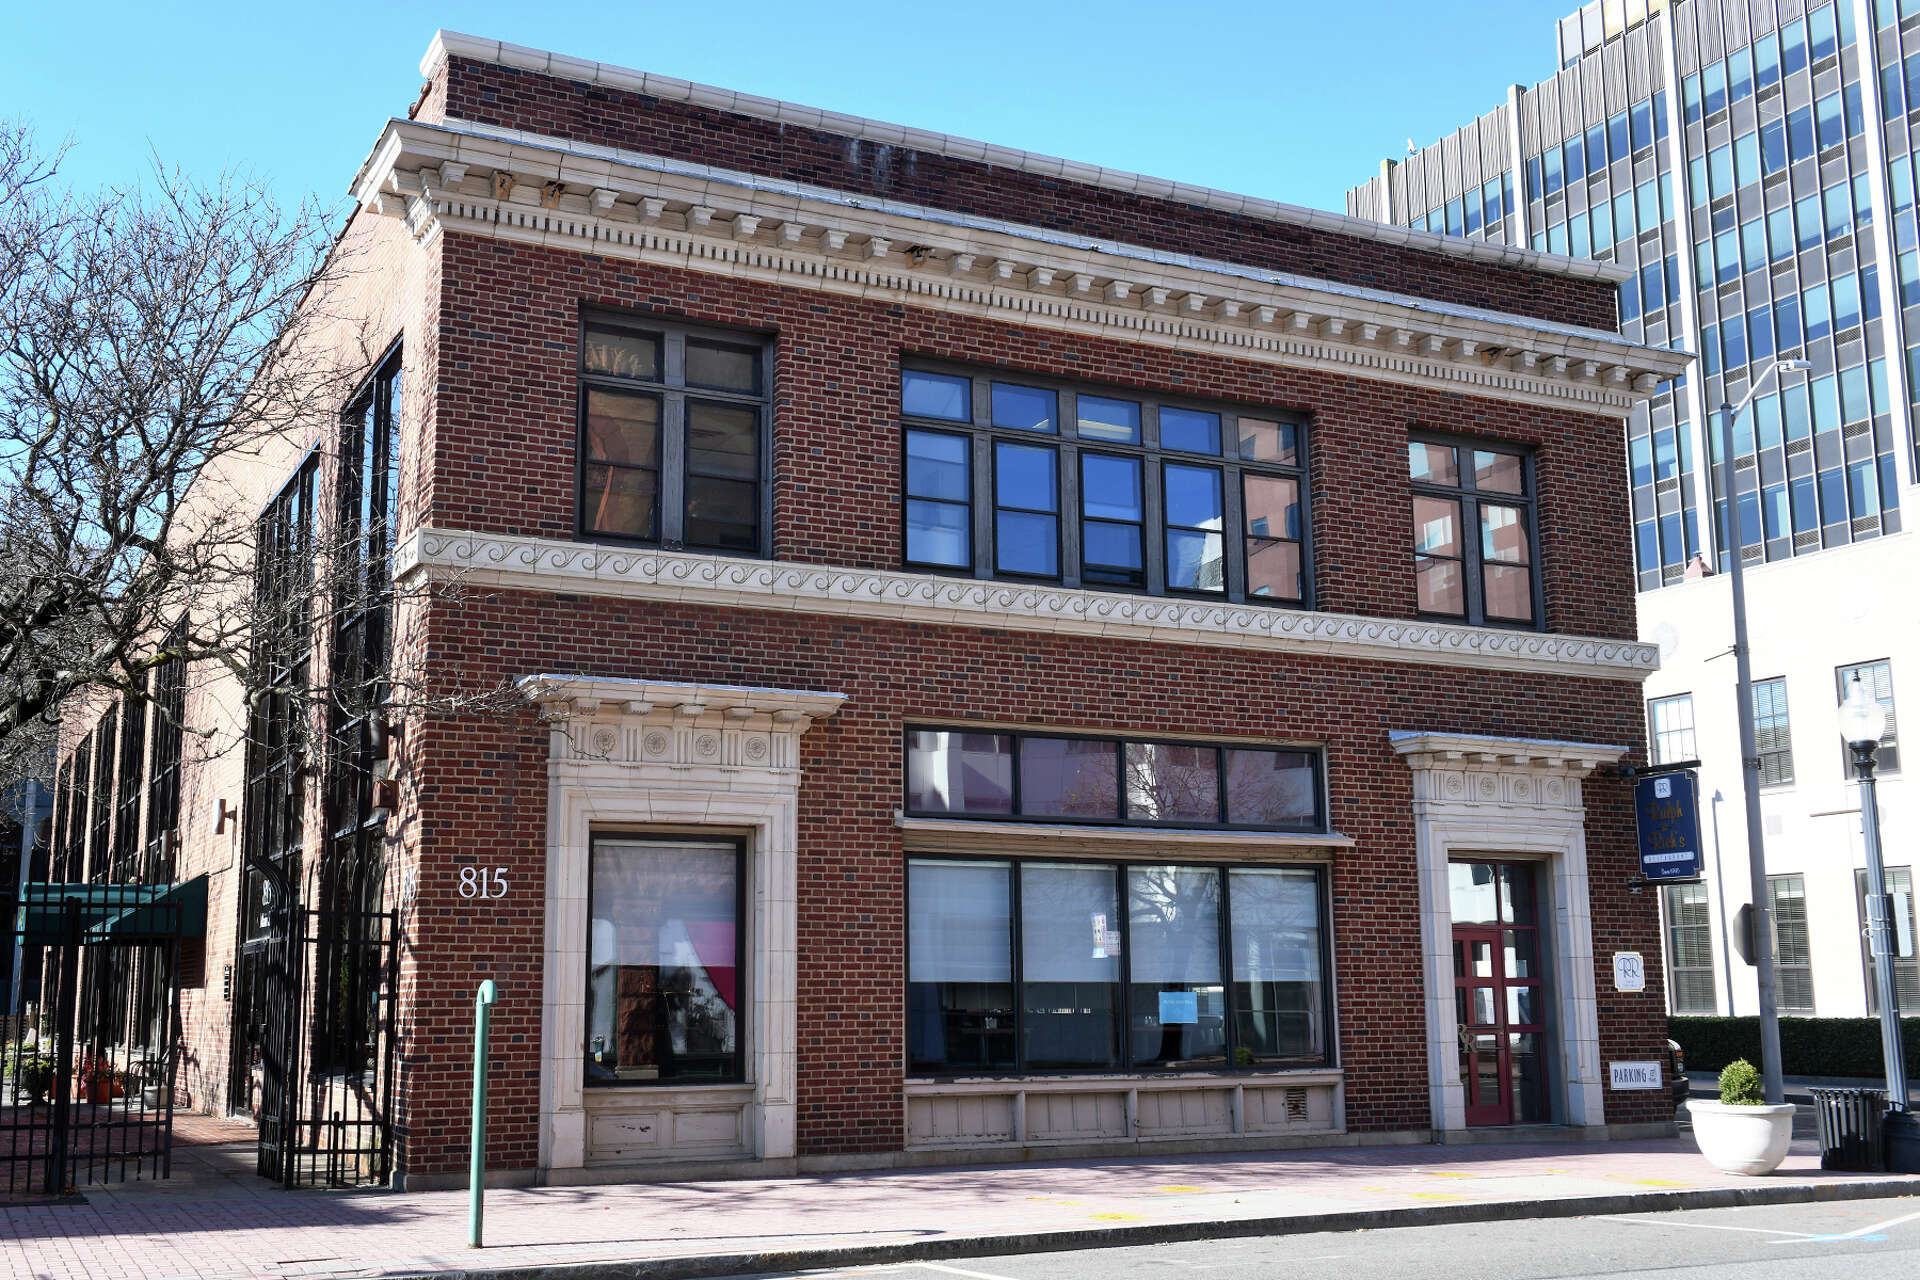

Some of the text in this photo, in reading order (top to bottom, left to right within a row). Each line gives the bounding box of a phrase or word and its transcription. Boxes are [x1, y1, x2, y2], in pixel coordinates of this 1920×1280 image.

[1646, 799, 1683, 824] Ralph
[1648, 831, 1687, 851] Rick's
[459, 866, 509, 899] 815
[1614, 1067, 1647, 1084] PARKING
